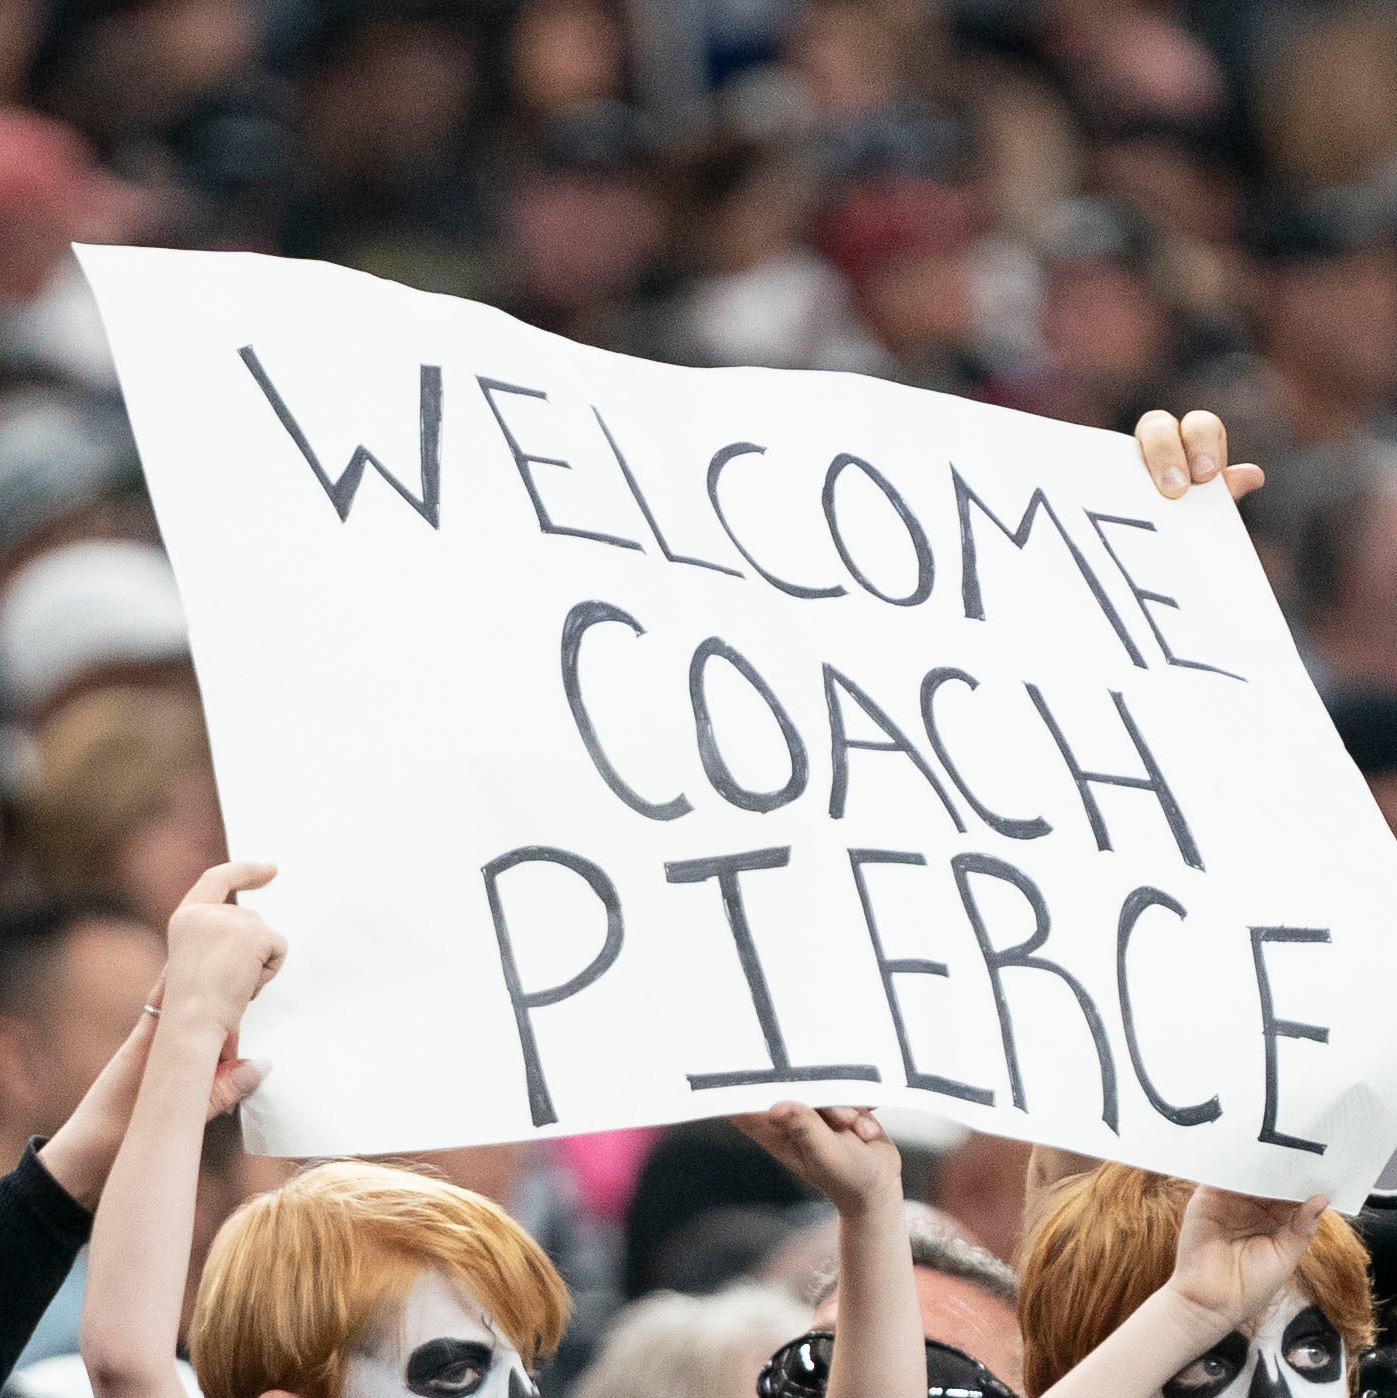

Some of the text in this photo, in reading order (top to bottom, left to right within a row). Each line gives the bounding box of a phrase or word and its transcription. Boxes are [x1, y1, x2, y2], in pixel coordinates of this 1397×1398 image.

[238, 343, 1248, 682] WELCOME
[560, 600, 1206, 872] COACH
[480, 846, 1333, 1156] PIERCE
